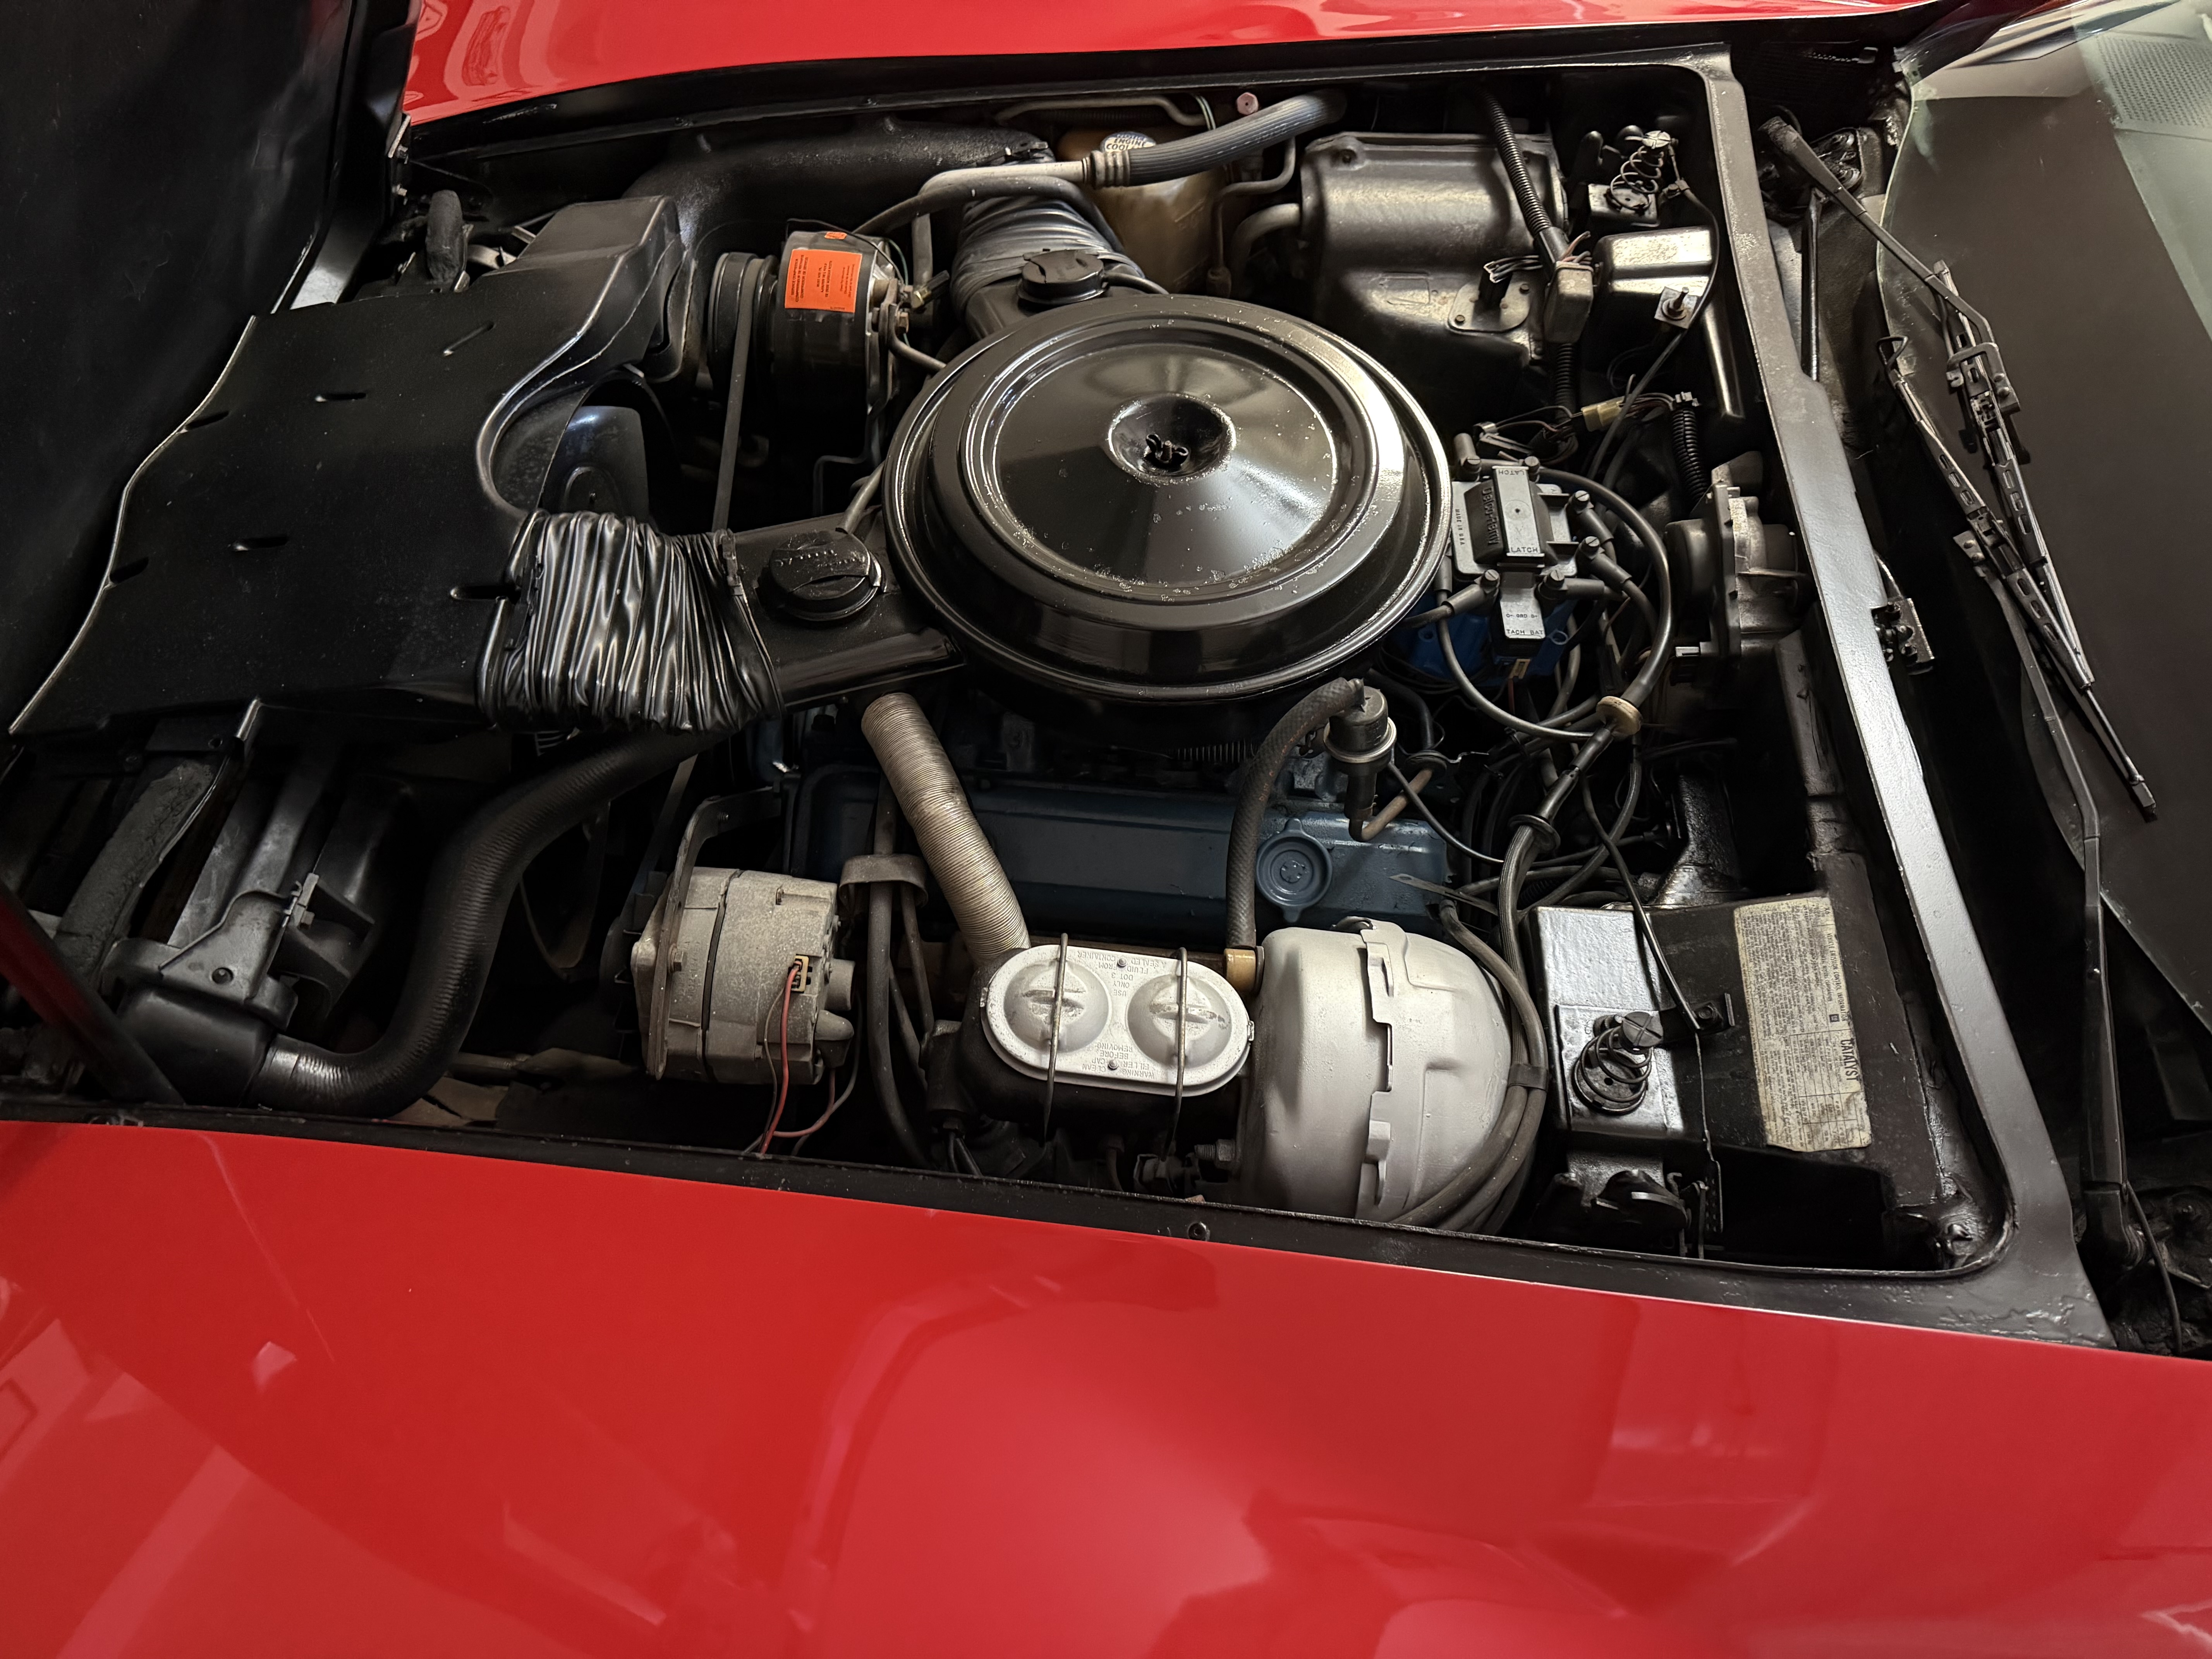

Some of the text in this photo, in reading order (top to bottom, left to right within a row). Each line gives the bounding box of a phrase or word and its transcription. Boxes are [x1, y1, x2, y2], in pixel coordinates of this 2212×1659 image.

[1114, 138, 1146, 147] ENGINE
[1482, 488, 1500, 546] Delco-Remy
[1077, 951, 1116, 962] CONTAINER
[1131, 958, 1159, 967] SEALED
[1830, 950, 1838, 970] EMISSION
[1127, 966, 1149, 974] FLUID
[1834, 972, 1842, 990] CONTROL
[1837, 993, 1847, 1021] INFORMATION
[1097, 1042, 1133, 1052] REMOVING
[1100, 1050, 1128, 1060] BEFORE
[1841, 1038, 1860, 1081] CATALYST
[1082, 1064, 1154, 1079] WARNING CLEAN
